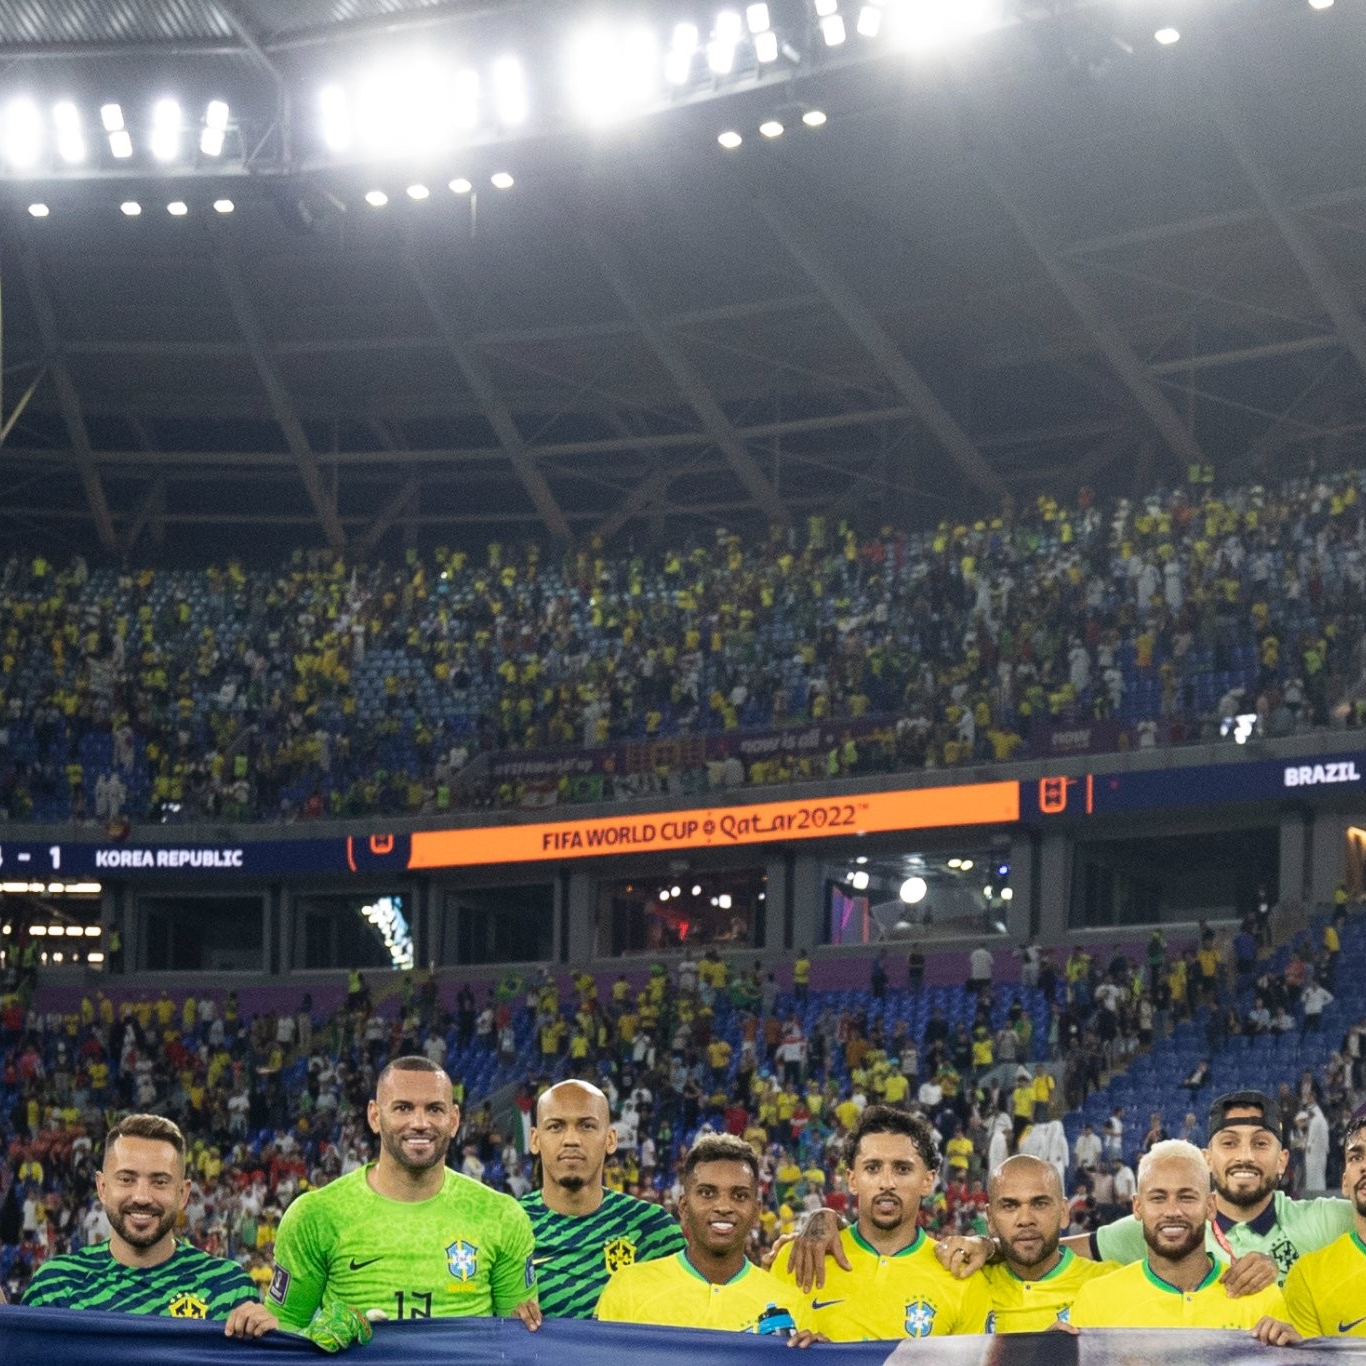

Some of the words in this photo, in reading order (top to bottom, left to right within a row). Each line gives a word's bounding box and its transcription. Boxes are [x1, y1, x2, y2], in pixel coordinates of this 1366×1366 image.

[1284, 762, 1360, 787] BRAZIL
[542, 831, 583, 852] FIFA
[585, 824, 656, 847] WORLD
[660, 819, 698, 841] CUP
[49, 846, 61, 869] 1
[96, 850, 154, 867] KOREA
[157, 849, 243, 867] REPUBLIC
